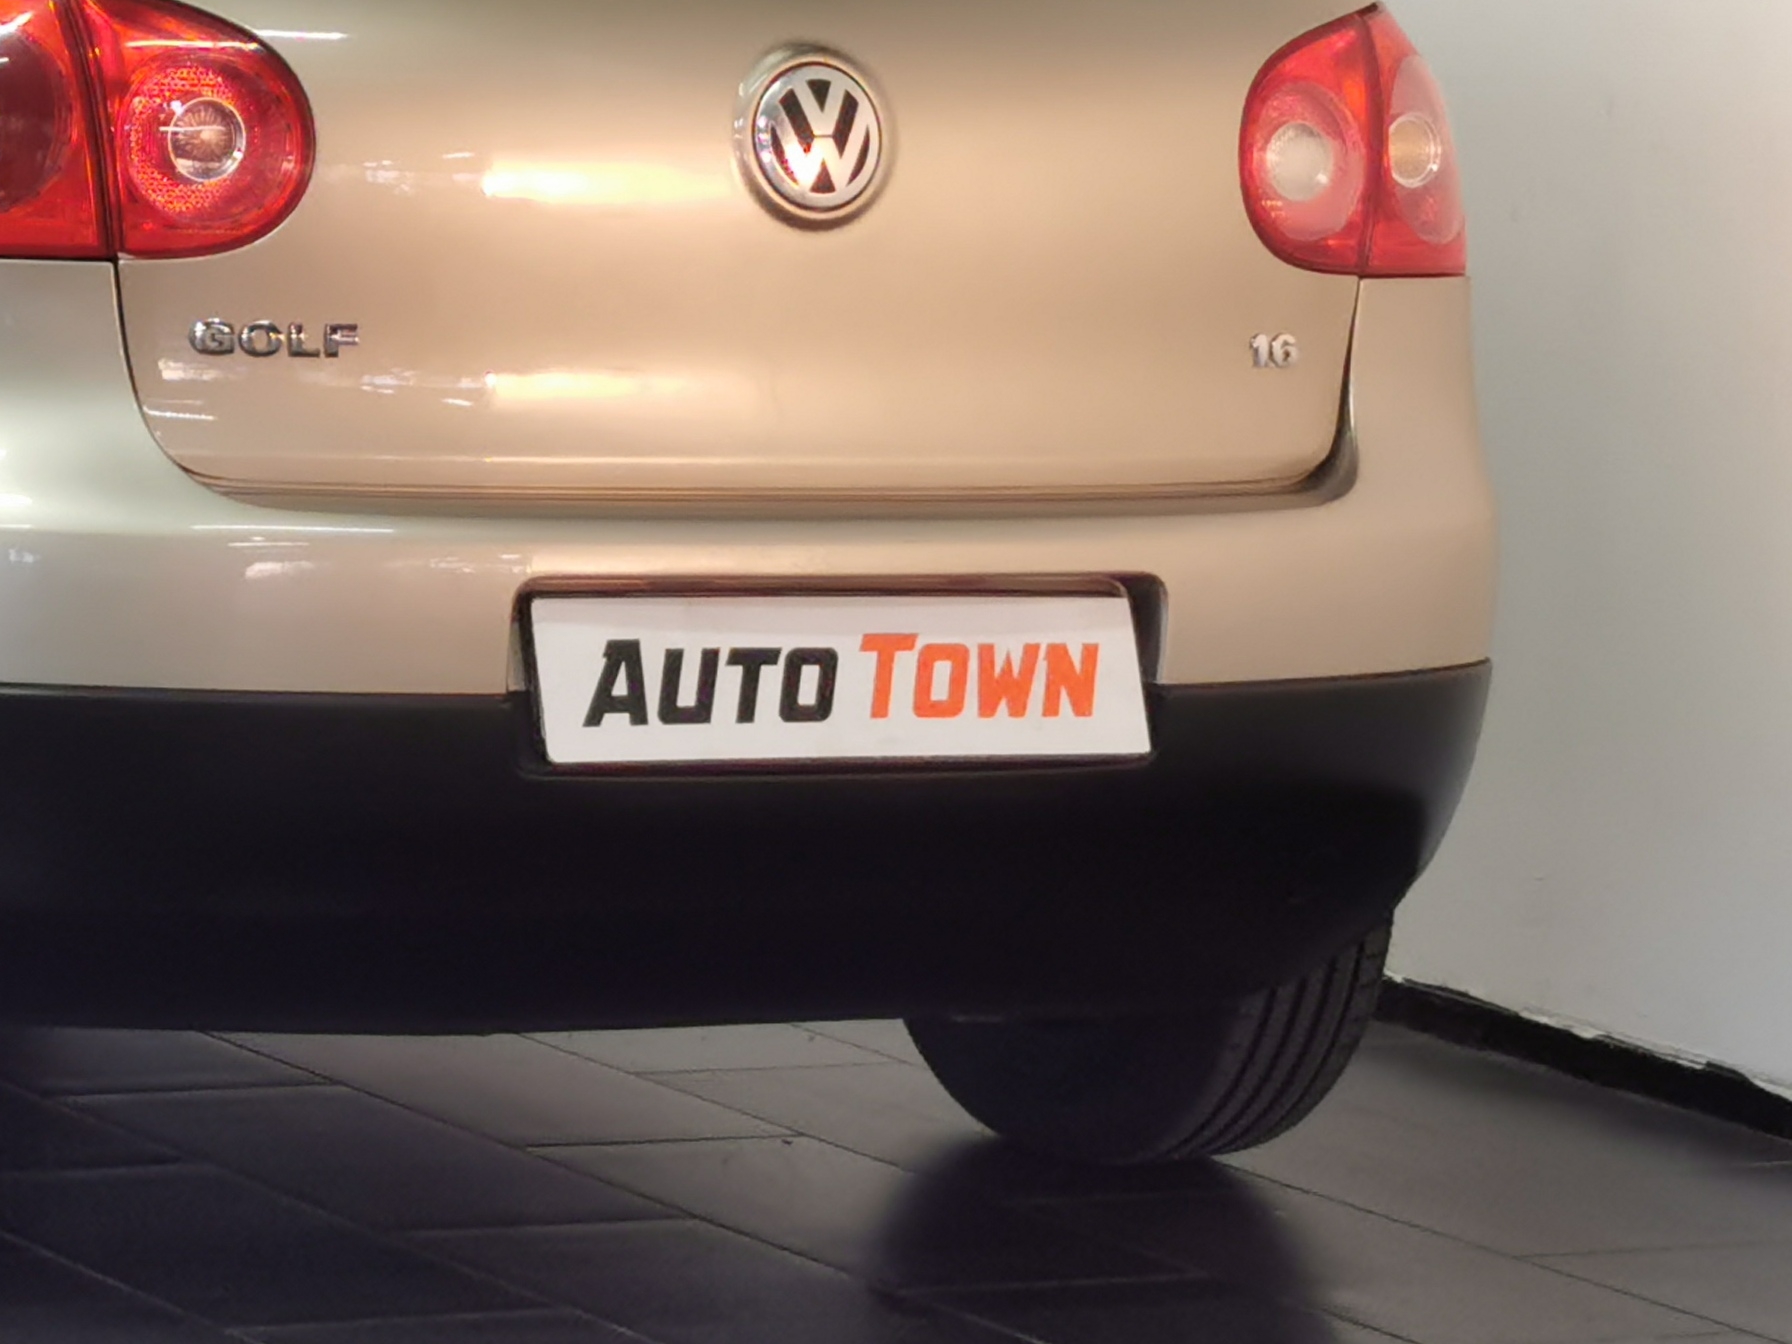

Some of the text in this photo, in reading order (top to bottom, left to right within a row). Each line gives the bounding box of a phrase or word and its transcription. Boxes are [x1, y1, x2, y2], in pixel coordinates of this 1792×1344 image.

[188, 318, 360, 358] GOLF
[582, 632, 1100, 728] AUTO TOWN
